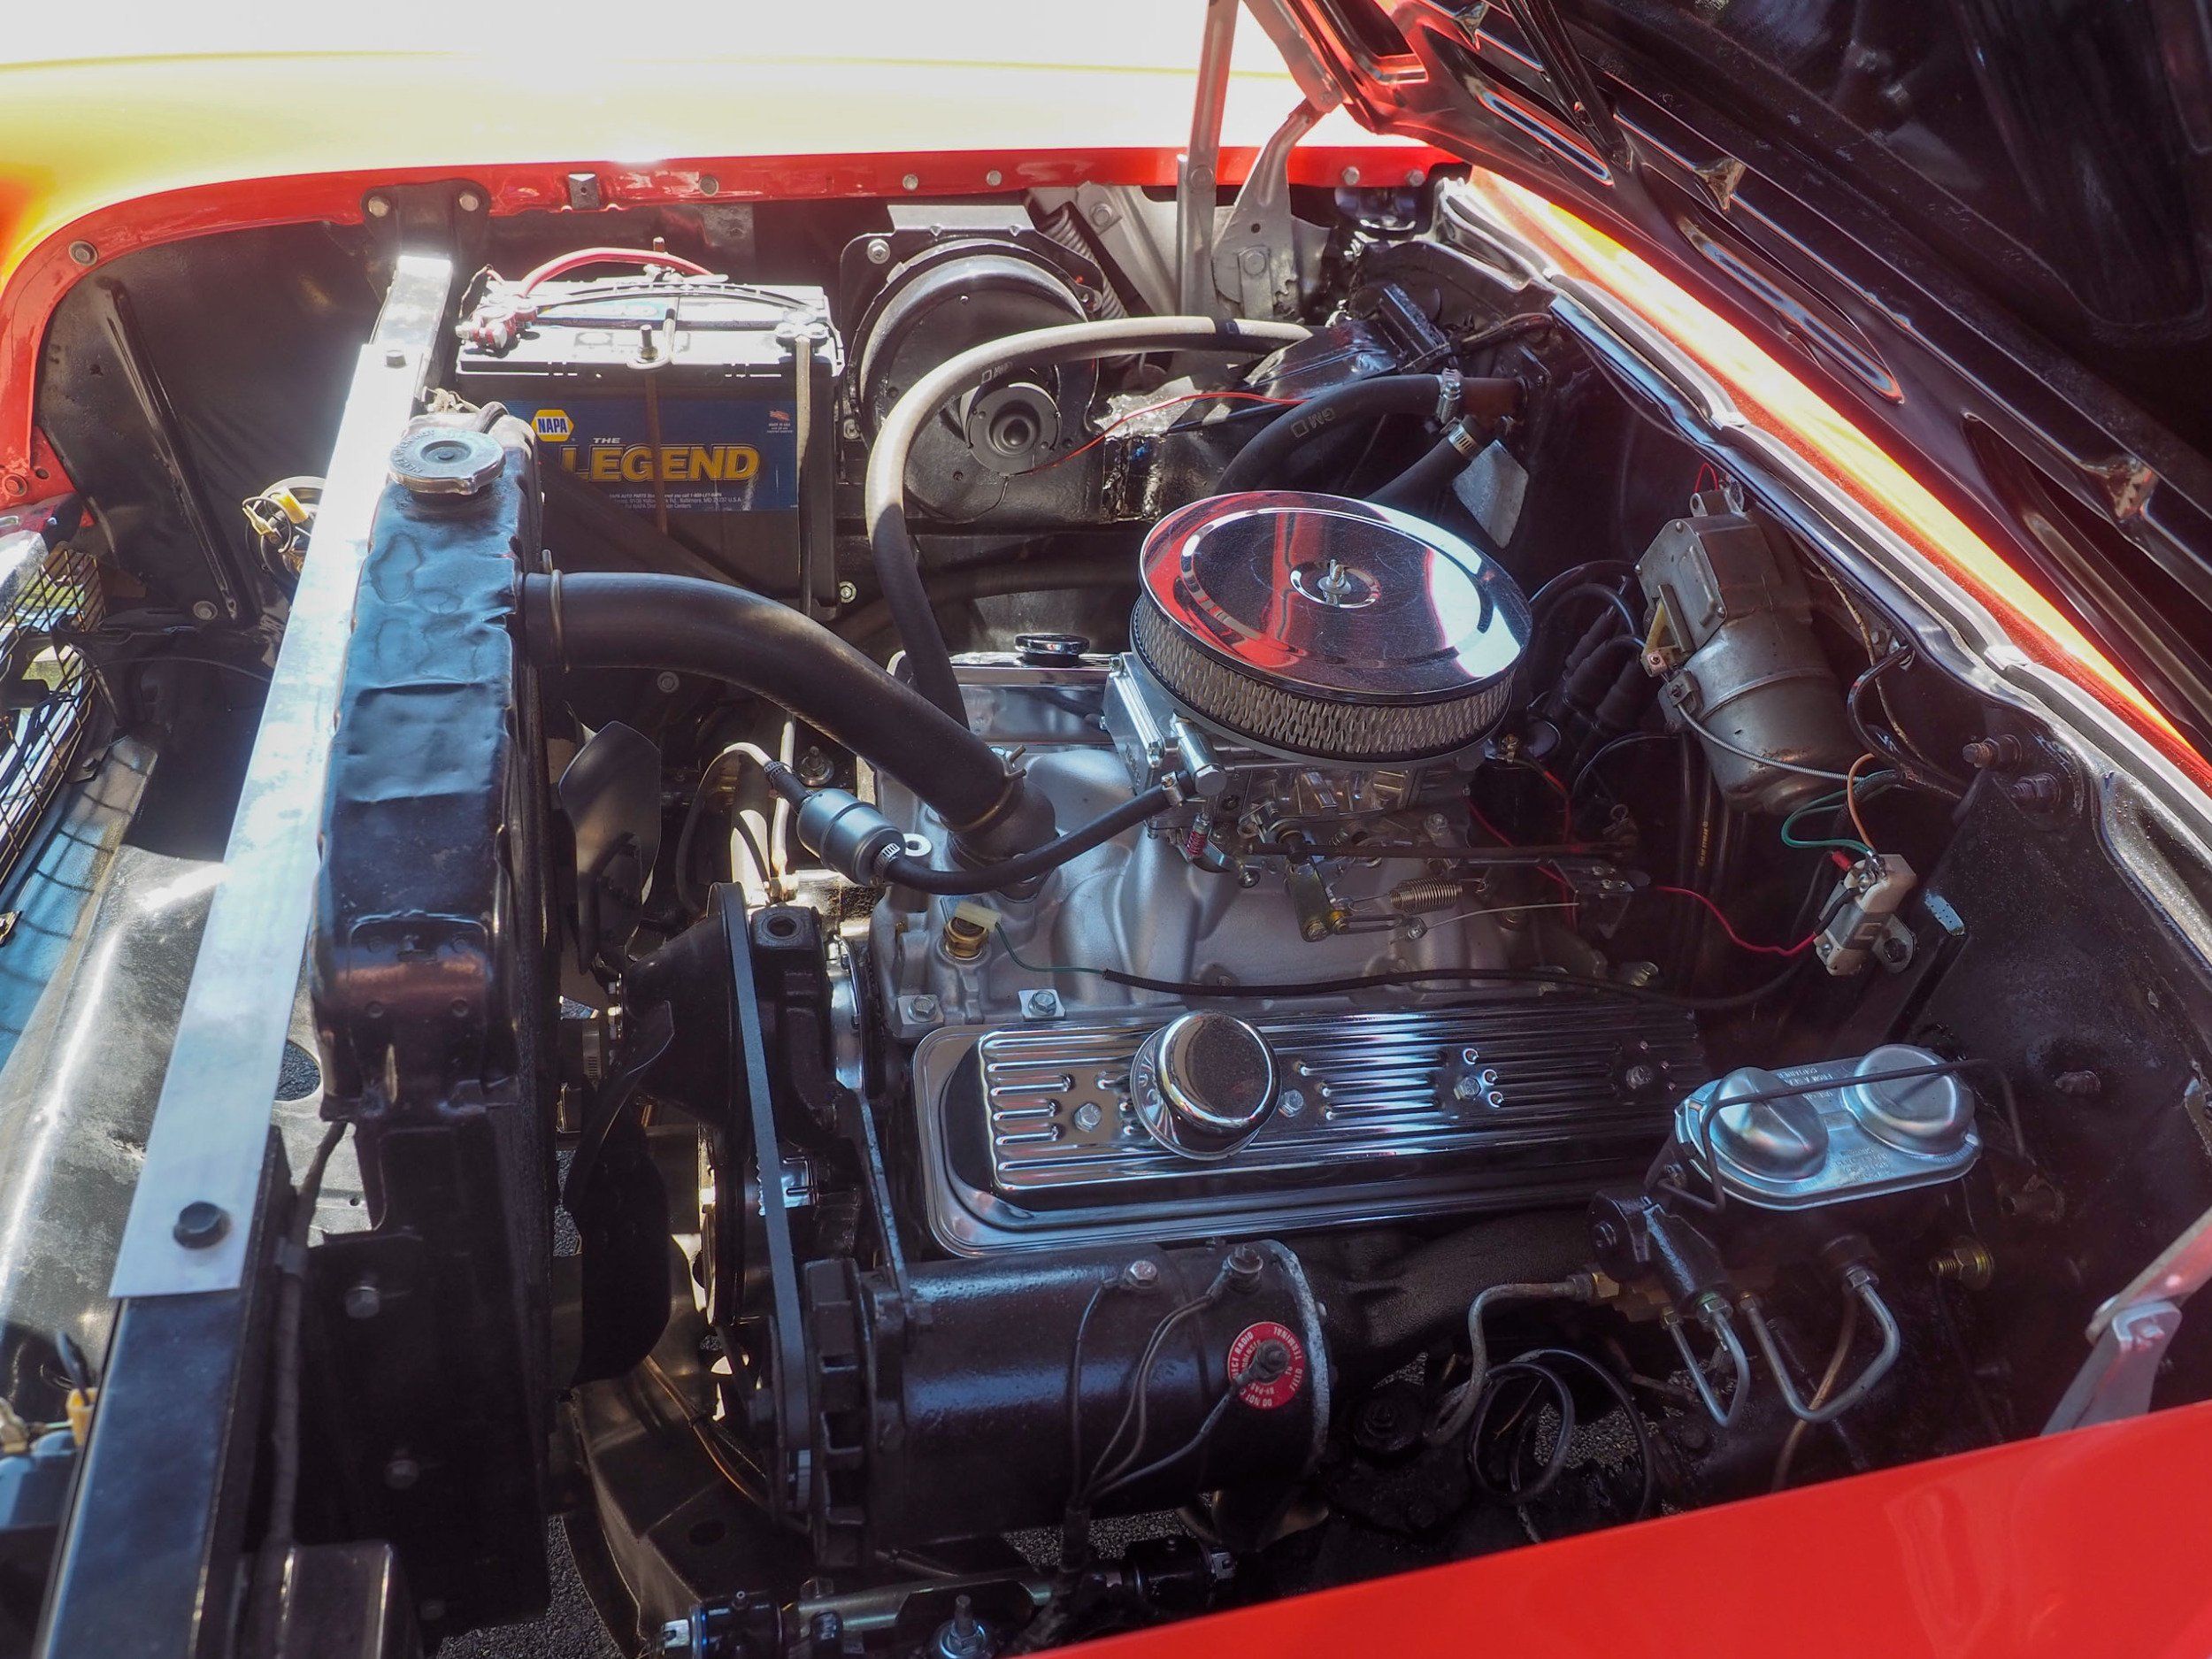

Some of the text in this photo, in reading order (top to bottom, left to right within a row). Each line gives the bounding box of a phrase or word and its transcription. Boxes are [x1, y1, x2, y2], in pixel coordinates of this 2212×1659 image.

[537, 418, 568, 434] NAPA
[1309, 408, 1335, 429] GM
[559, 443, 760, 482] LEGEND
[1234, 1331, 1255, 1355] RADIO
[1273, 1325, 1302, 1360] TERMINAL
[1245, 1394, 1261, 1406] NOT
[1262, 1398, 1273, 1407] DO
